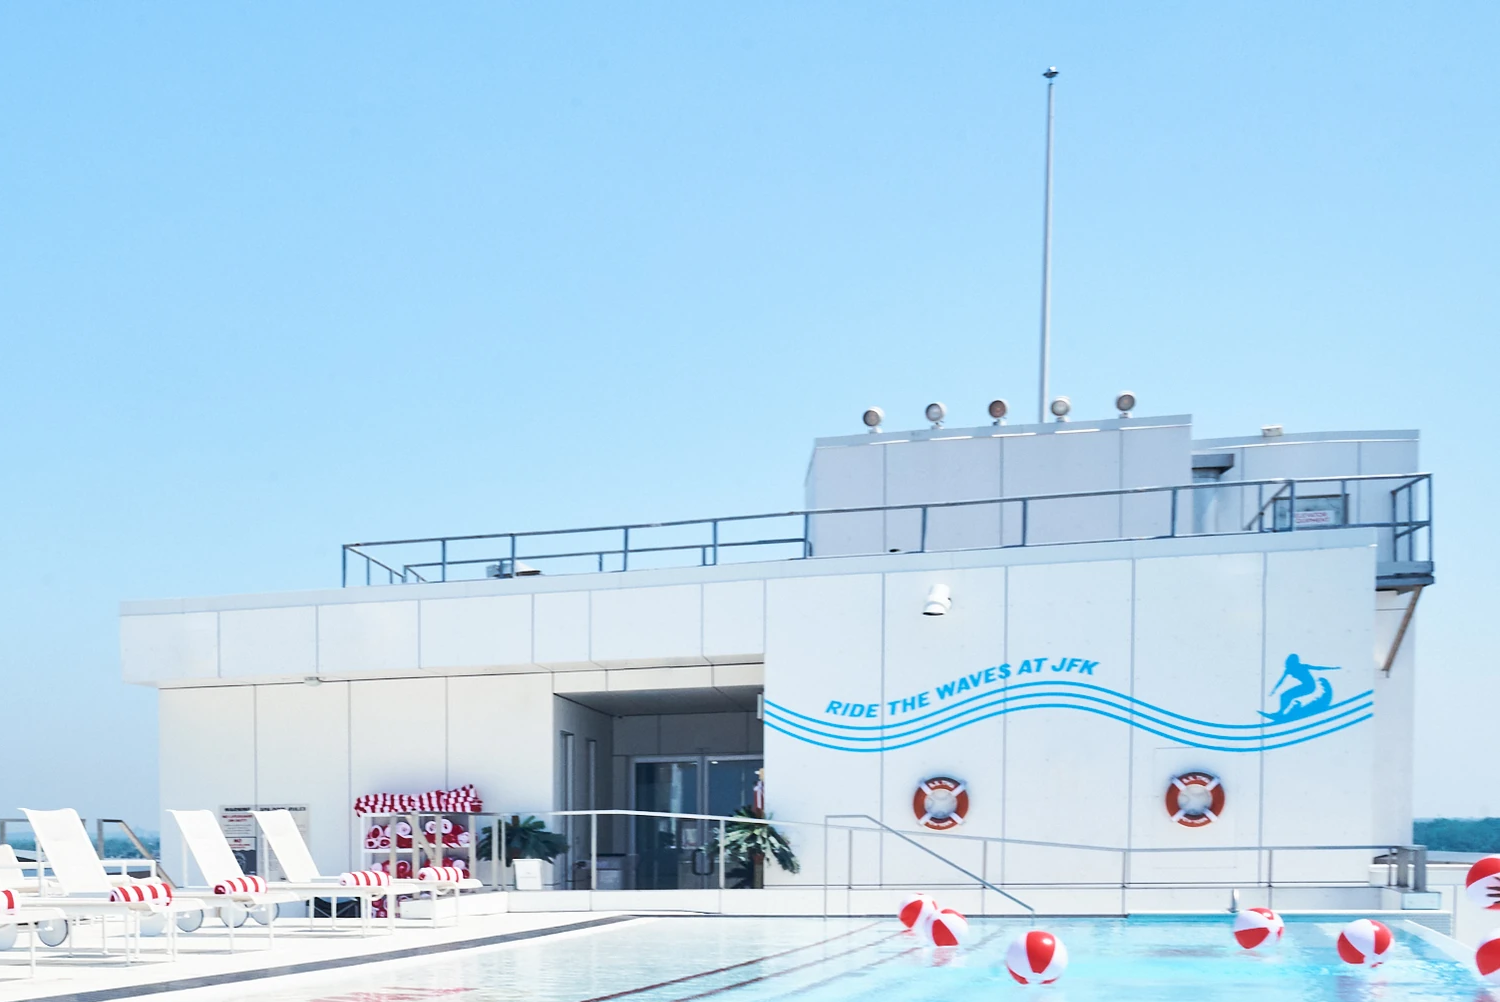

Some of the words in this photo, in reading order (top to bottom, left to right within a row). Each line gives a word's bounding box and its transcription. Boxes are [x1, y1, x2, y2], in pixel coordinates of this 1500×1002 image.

[825, 700, 880, 718] RIDE
[887, 691, 931, 716] THE
[935, 662, 1012, 700] WAVES
[1017, 657, 1049, 675] AT
[1051, 657, 1100, 675] JFK
